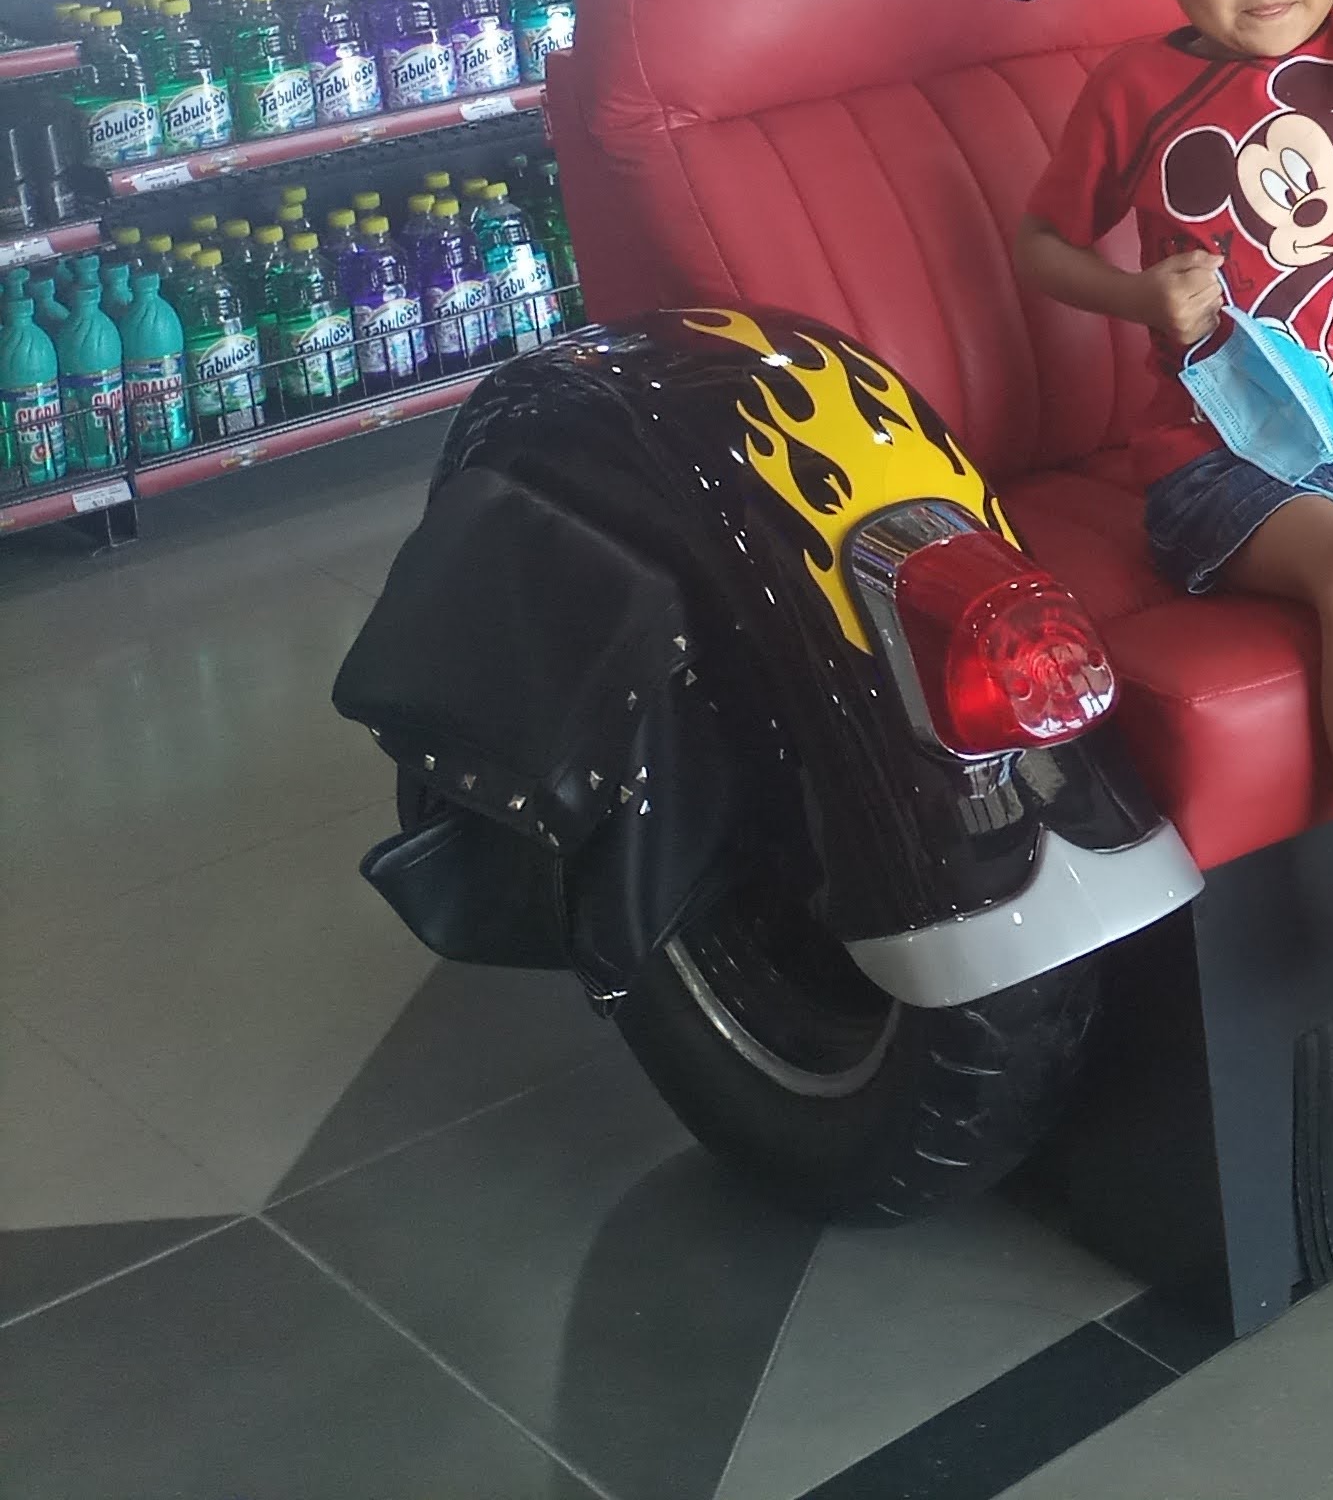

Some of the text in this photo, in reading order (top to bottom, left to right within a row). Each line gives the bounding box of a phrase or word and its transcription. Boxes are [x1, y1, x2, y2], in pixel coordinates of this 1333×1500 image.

[391, 49, 450, 88] Fabuloso
[460, 34, 514, 74] Fabuoso
[258, 77, 311, 116] Fabulos
[316, 59, 375, 101] Fabuoso
[88, 107, 155, 145] Fabuloso
[162, 91, 227, 132] Fabuloso
[434, 282, 487, 318] Fabuloso
[495, 263, 547, 301] Fabuoso
[198, 339, 257, 381] Fabuloso
